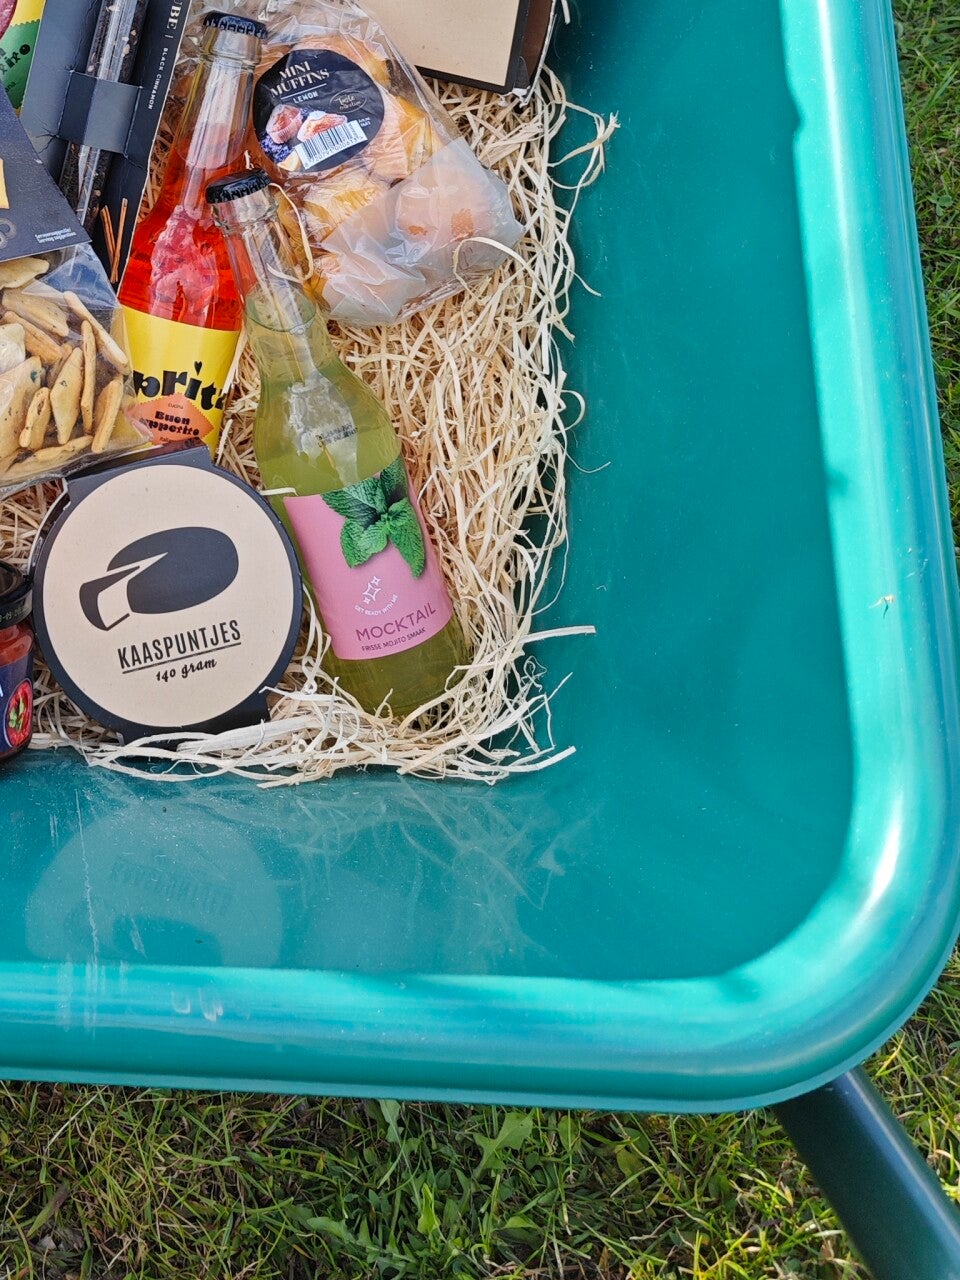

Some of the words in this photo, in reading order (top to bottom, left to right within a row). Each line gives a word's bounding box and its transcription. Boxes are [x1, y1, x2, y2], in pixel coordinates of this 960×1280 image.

[158, 47, 169, 71] BLACK
[279, 61, 311, 80] MINI
[148, 74, 162, 110] CINNAMON
[269, 68, 329, 97] MUFFINS
[293, 91, 319, 104] LEMON
[155, 410, 190, 425] Buon
[355, 602, 436, 641] MOCKTAIL
[117, 620, 241, 669] KAASPUNTJES
[361, 643, 382, 652] FRISSE
[383, 636, 407, 648] MOJITO
[406, 627, 426, 641] SMAAK
[156, 668, 176, 682] 140
[181, 659, 218, 679] gram
